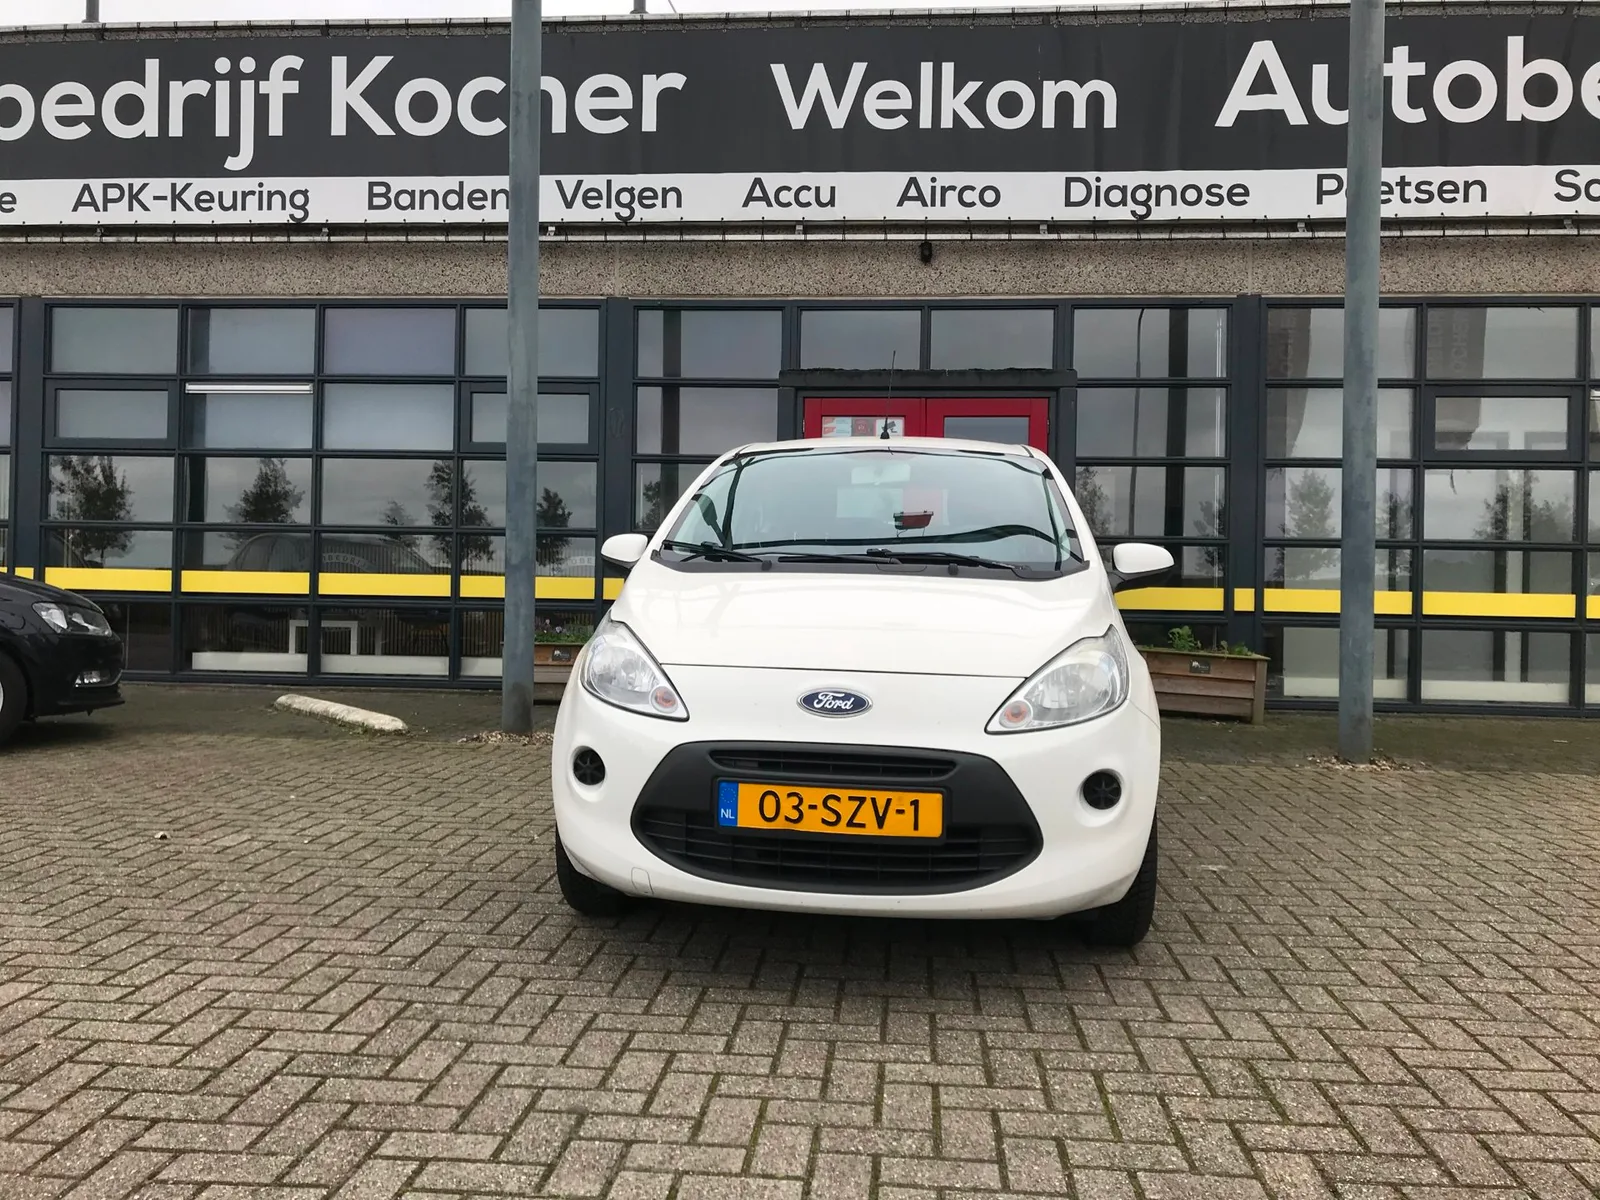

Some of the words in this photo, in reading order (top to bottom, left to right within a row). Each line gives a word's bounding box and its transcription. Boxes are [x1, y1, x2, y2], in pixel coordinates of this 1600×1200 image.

[770, 61, 1118, 130] Welkom
[71, 182, 310, 223] APK-Keuring
[367, 181, 510, 211] Banden
[555, 178, 682, 221] Velgen
[741, 176, 837, 209] Accu
[897, 175, 1002, 209] Airco
[1063, 175, 1250, 220] Diagnose
[1316, 174, 1487, 206] Petsen
[813, 691, 854, 711] Ford
[720, 808, 736, 819] NL
[758, 789, 921, 832] 03-SZV-1
